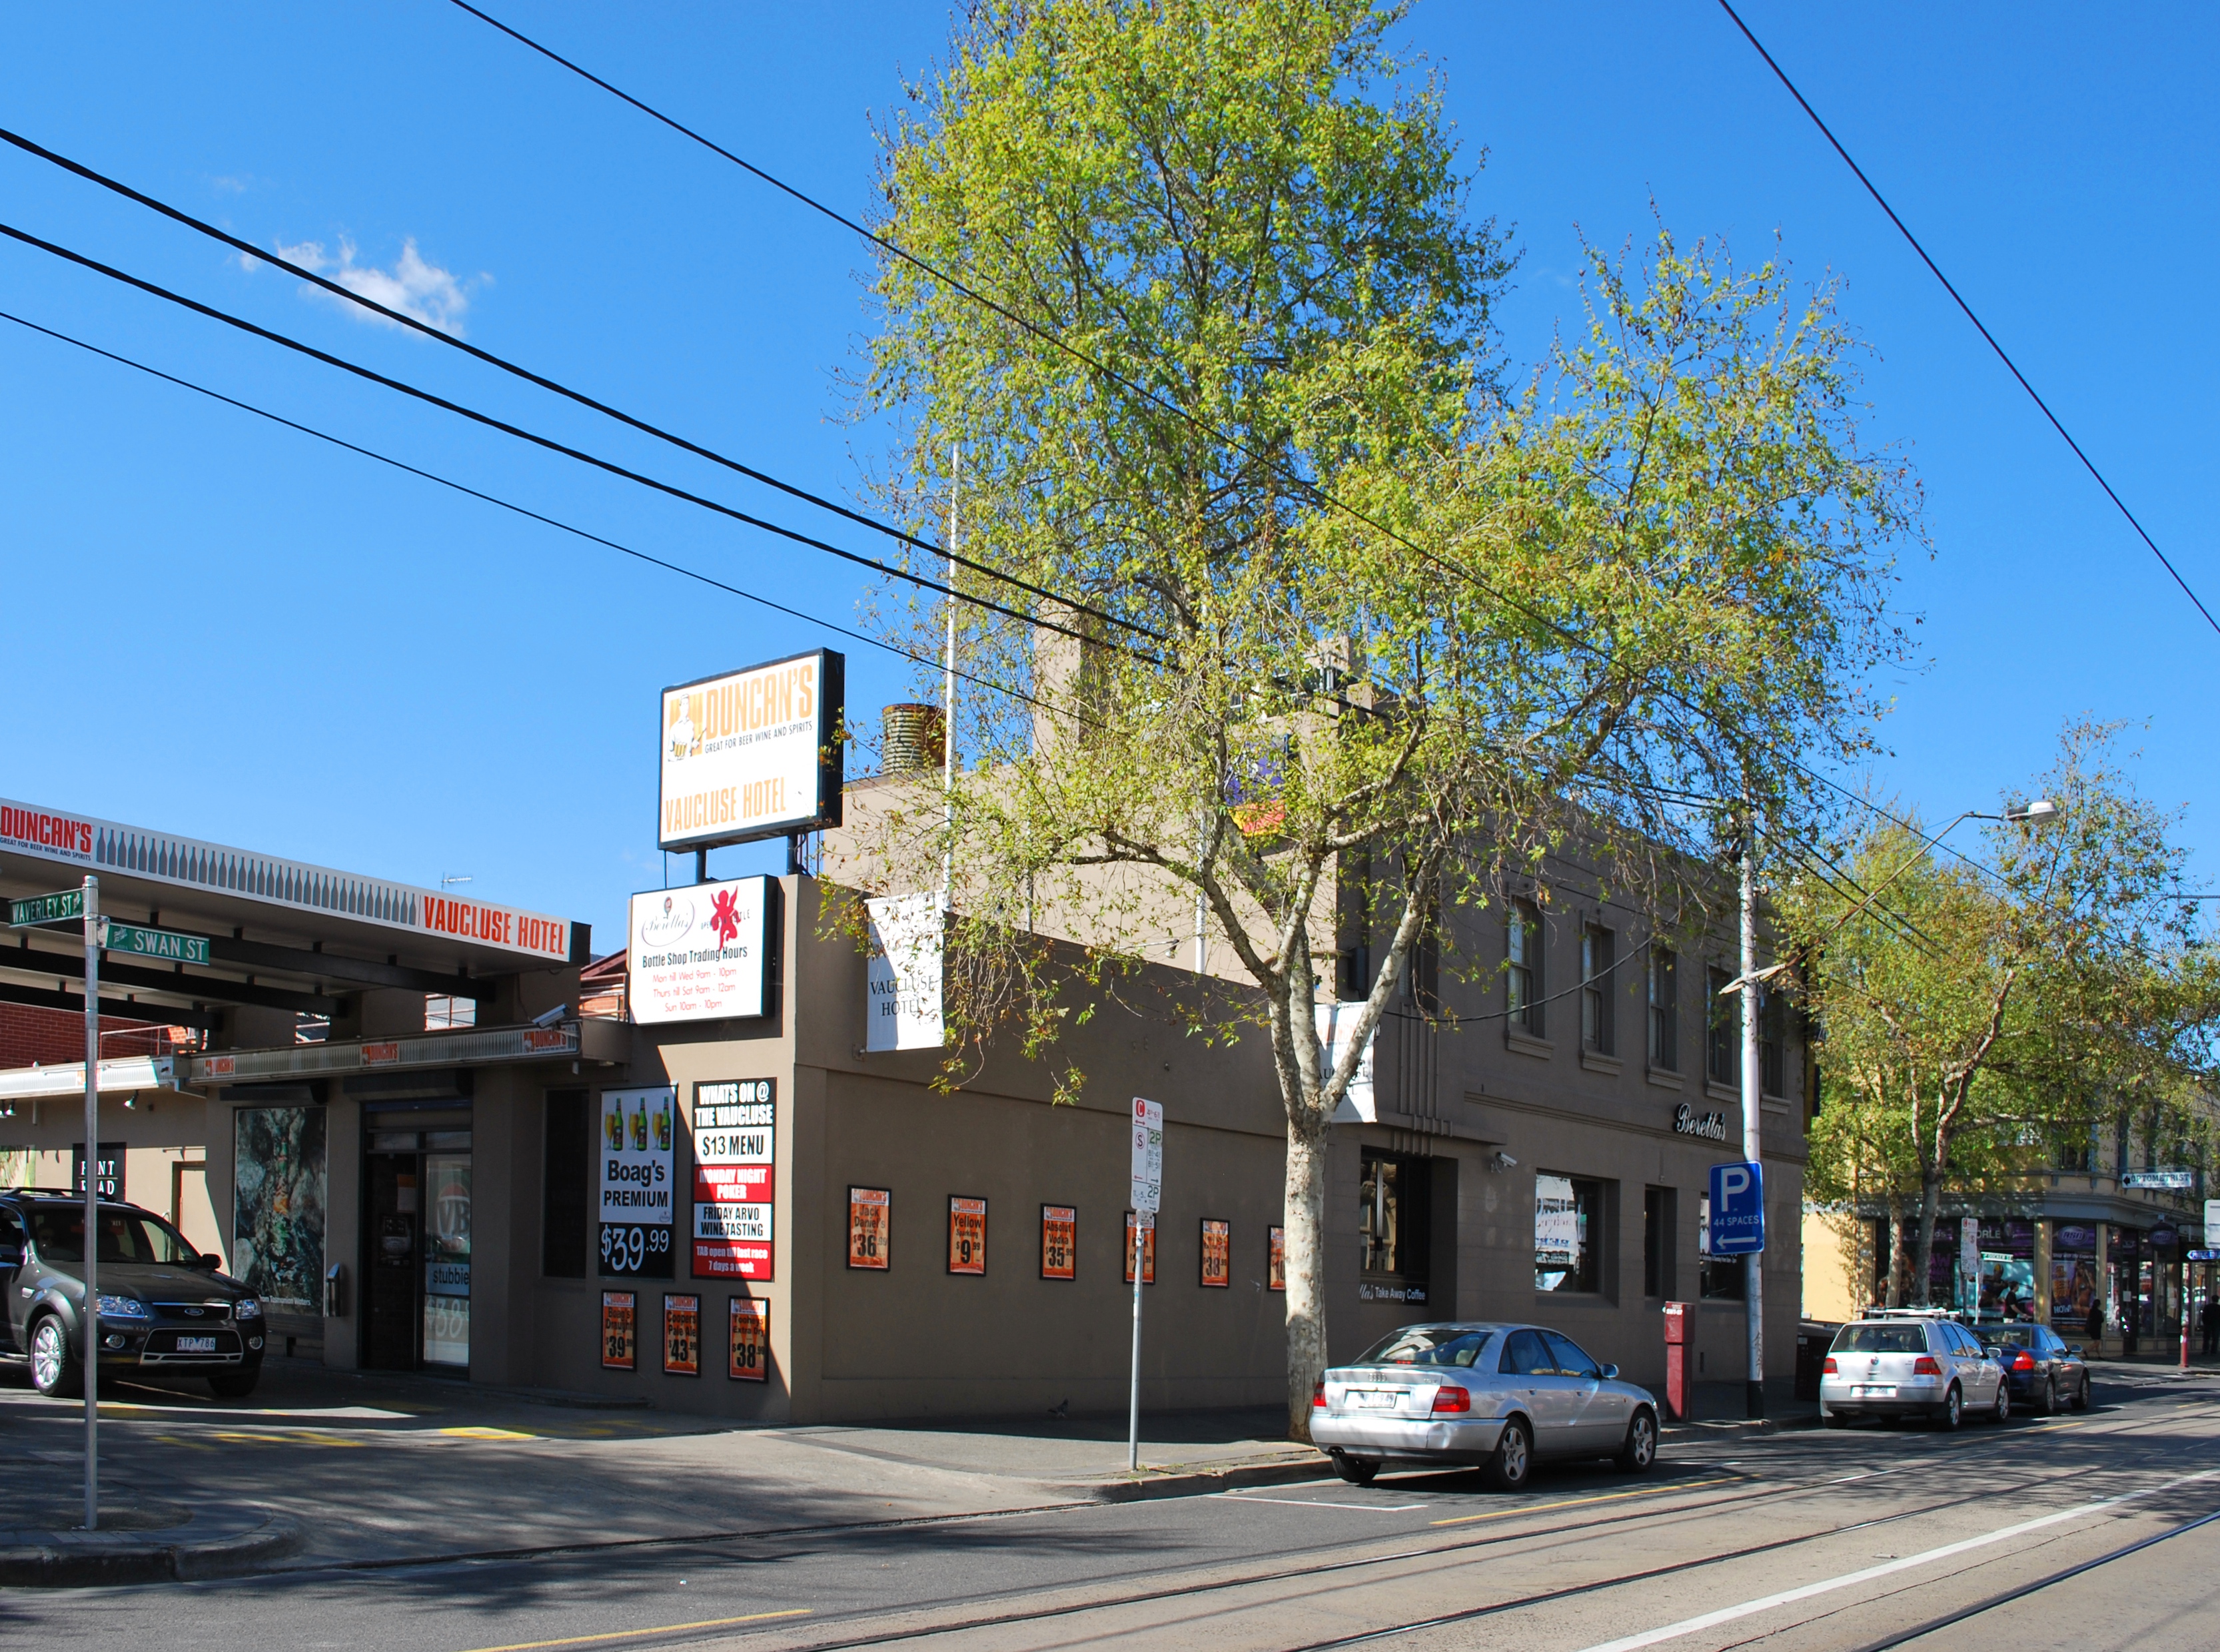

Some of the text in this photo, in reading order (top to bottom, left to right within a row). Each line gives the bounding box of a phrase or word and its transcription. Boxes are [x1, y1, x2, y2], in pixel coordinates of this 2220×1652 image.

[706, 664, 813, 741] DUNCAN'S
[704, 720, 813, 754] GREAT FOR BEER WINE AND SPIRITS
[666, 776, 787, 833] VAUCLUSE HOTEL
[0, 805, 92, 853] DUNCAN'S
[0, 837, 17, 846] GREAT
[30, 843, 43, 852] BEER
[44, 845, 59, 855] WINE
[59, 849, 71, 857] AND
[72, 851, 92, 861] SPIRITS
[12, 895, 73, 923] WAVERLEY ST
[424, 895, 564, 955] VAUCLUSE HOTEL
[134, 931, 205, 961] SWAN ST
[642, 946, 748, 969] Bottle Shop Trading Hours
[652, 974, 667, 983] Mon
[678, 970, 694, 981] Wed
[696, 969, 712, 979] 9am
[718, 967, 737, 979] 10pm
[653, 989, 671, 998] Thurs
[682, 986, 693, 996] Sat
[695, 985, 710, 995] 9am
[718, 983, 736, 993] 12am
[665, 1003, 677, 1013] Sun
[680, 1001, 697, 1011] 10am
[704, 999, 722, 1011] 10pm
[698, 1081, 770, 1105] WHATS ON @
[694, 1104, 774, 1127] THE VAUCLUSE
[1676, 1102, 1726, 1141] Beretta's
[1149, 1130, 1161, 1145] 2P
[702, 1134, 764, 1158] $13 MENU
[607, 1159, 665, 1188] Boag's
[699, 1168, 767, 1184] MONDAY NIGHT
[2131, 1174, 2191, 1182] OPTOMETRIST
[716, 1184, 747, 1200] POKER
[1147, 1185, 1159, 1199] 2P
[1721, 1166, 1750, 1212] P
[604, 1190, 668, 1208] PREMIUM
[703, 1206, 760, 1220] FRIDAY ARVO
[859, 1205, 879, 1217] Jack
[700, 1222, 764, 1236] WINE TASTING
[854, 1216, 886, 1228] Daniel's
[953, 1214, 982, 1228] Yellow
[1046, 1220, 1071, 1233] Absolut
[1713, 1215, 1760, 1227] 44 SPACES
[1048, 1233, 1069, 1245] Vodka
[600, 1224, 670, 1271] $39.99
[696, 1246, 709, 1256] TAB
[709, 1247, 726, 1258] open
[737, 1246, 751, 1258] last
[751, 1248, 768, 1260] race
[956, 1239, 981, 1264] $9.99
[708, 1260, 754, 1273] 7 days a week
[1375, 1286, 1389, 1299] Take
[1389, 1288, 1406, 1302] Away
[1406, 1288, 1426, 1300] Coffee
[667, 1311, 696, 1326] Coopers
[732, 1314, 764, 1327] Tooheys
[668, 1324, 696, 1337] Pale Ale
[733, 1326, 764, 1338] Extra Dry
[178, 1338, 215, 1348] XTP 786
